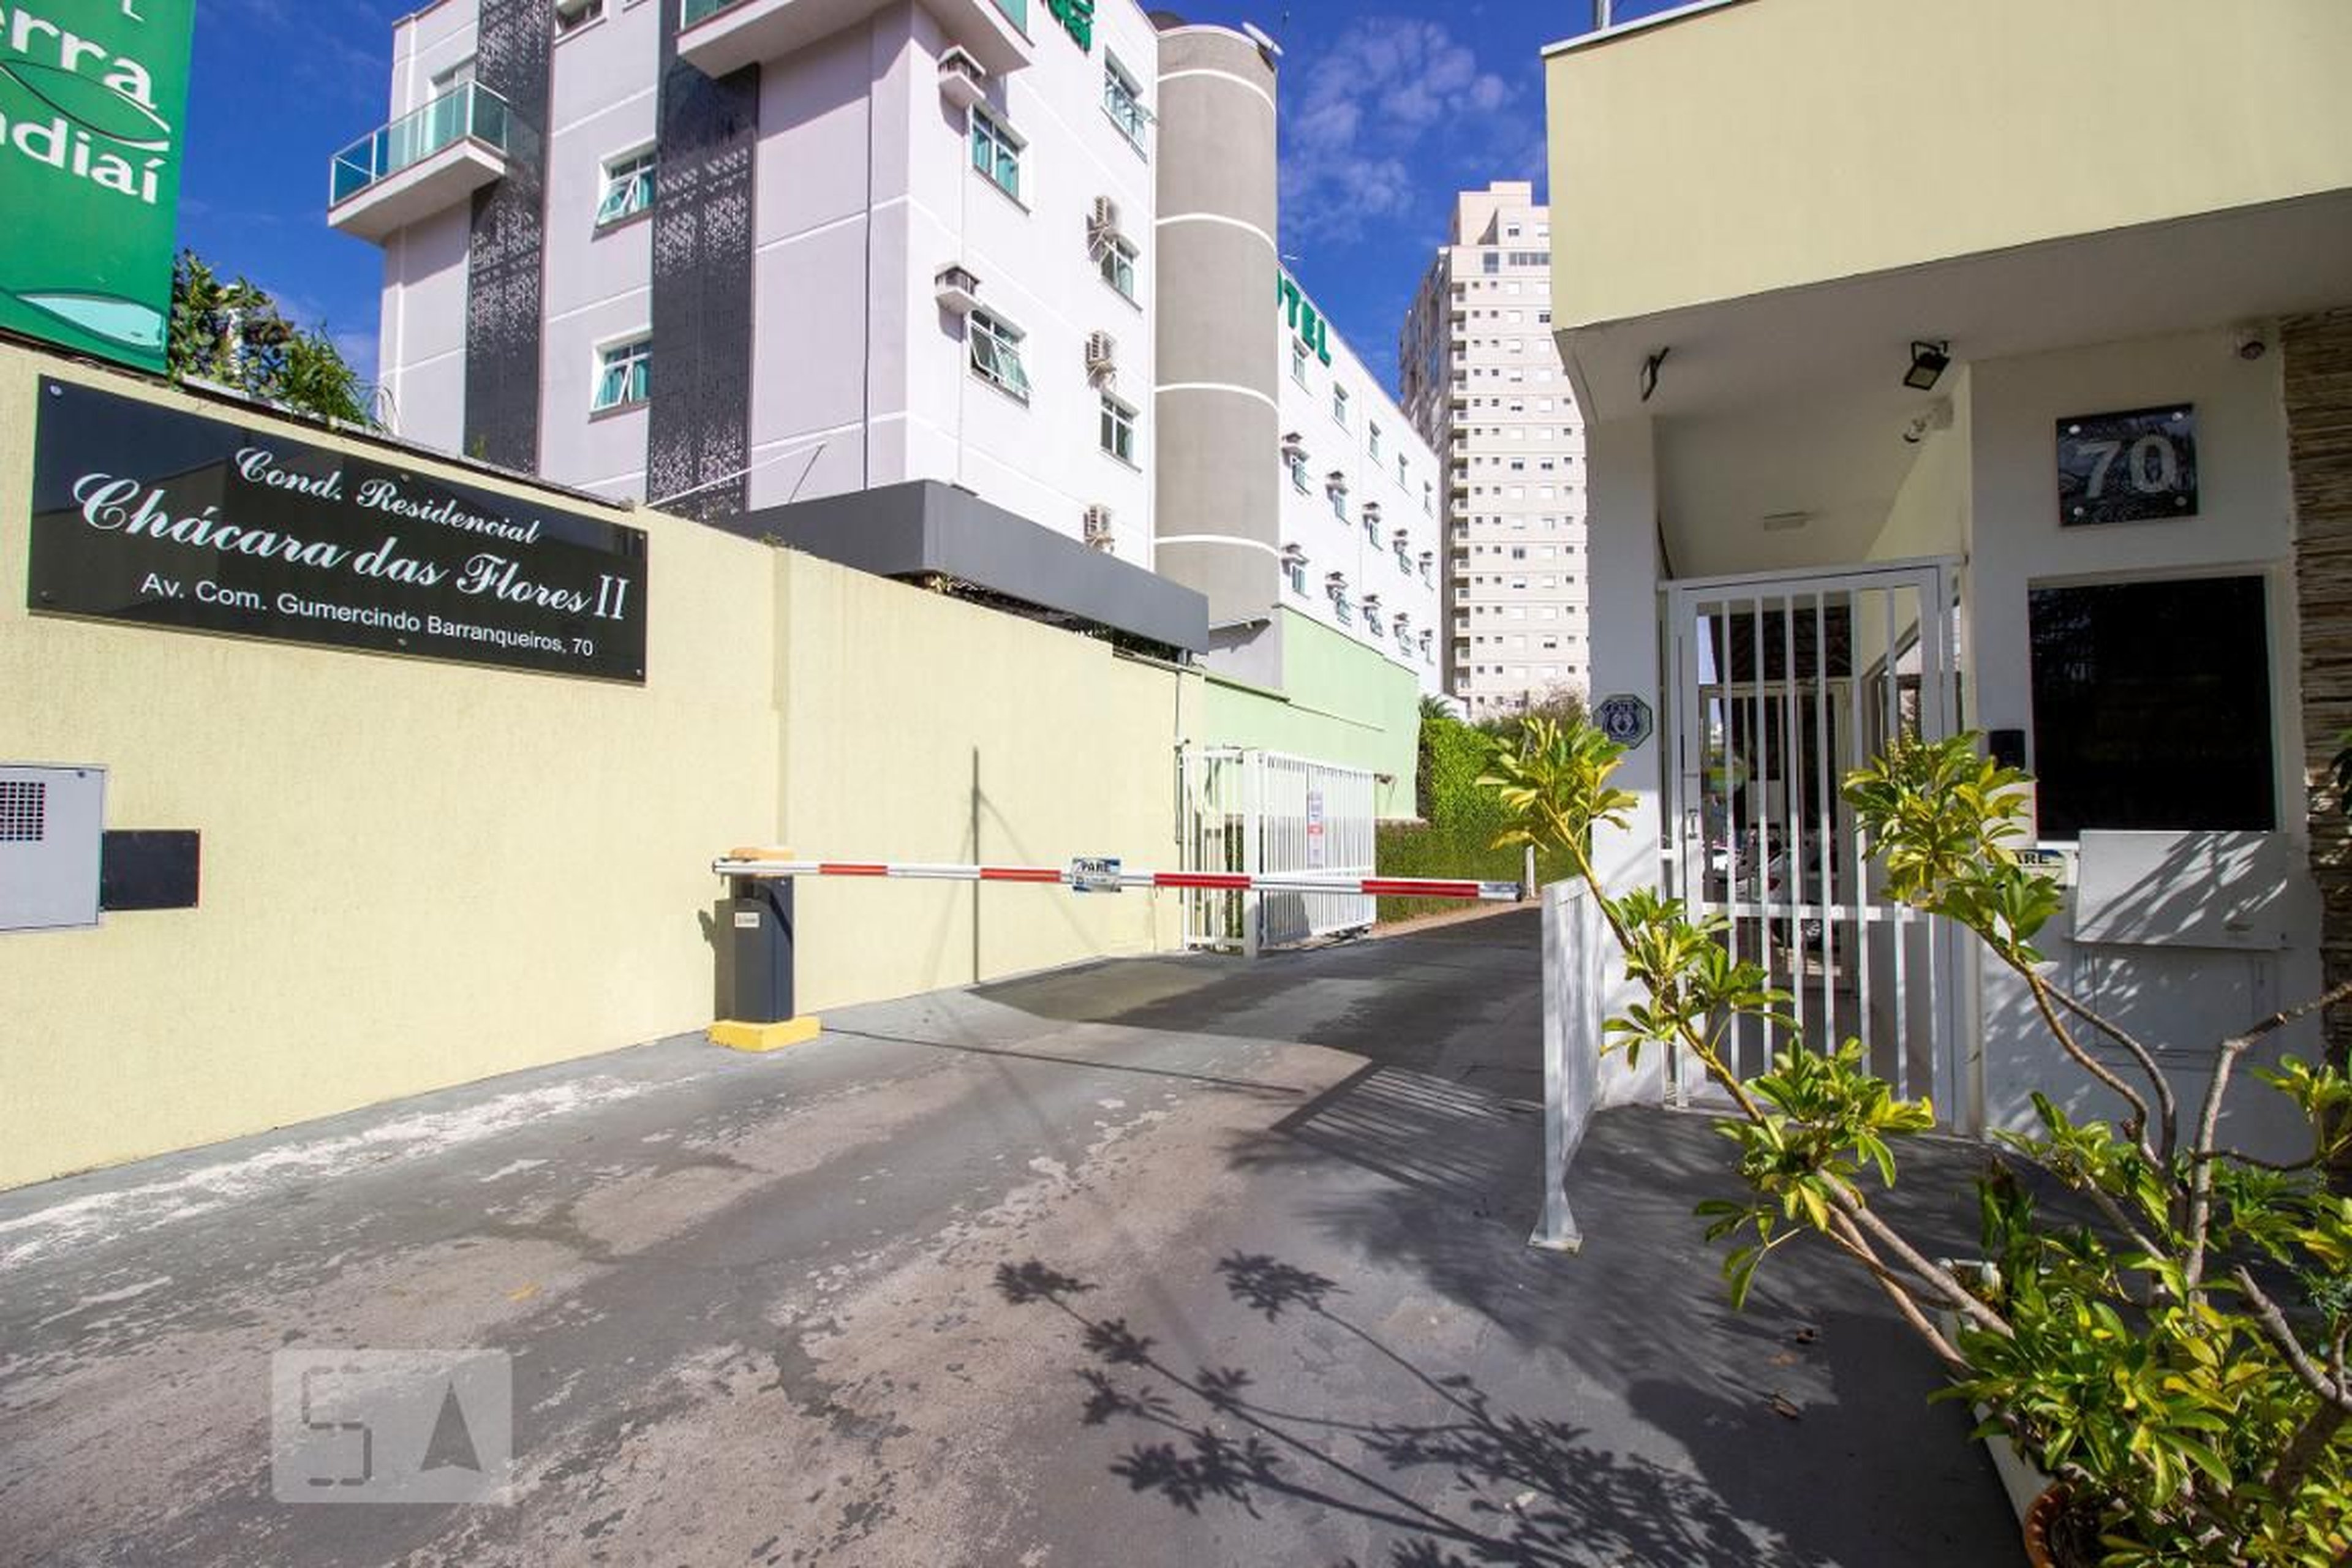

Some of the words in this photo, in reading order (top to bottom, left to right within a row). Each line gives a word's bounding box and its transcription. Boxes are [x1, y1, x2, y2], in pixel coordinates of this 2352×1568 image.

[0, 6, 157, 110] rra
[1278, 268, 1332, 368] TEL
[235, 447, 342, 501] Cond.
[356, 478, 540, 545] Residencial
[2077, 434, 2176, 497] 70
[73, 472, 352, 569] Chácara
[353, 536, 450, 586] das
[456, 552, 592, 612] Flores
[594, 573, 630, 620] II
[140, 573, 184, 599] Av.
[195, 580, 267, 611] Com.
[277, 592, 421, 632] Gumercindo
[571, 638, 594, 657] 70
